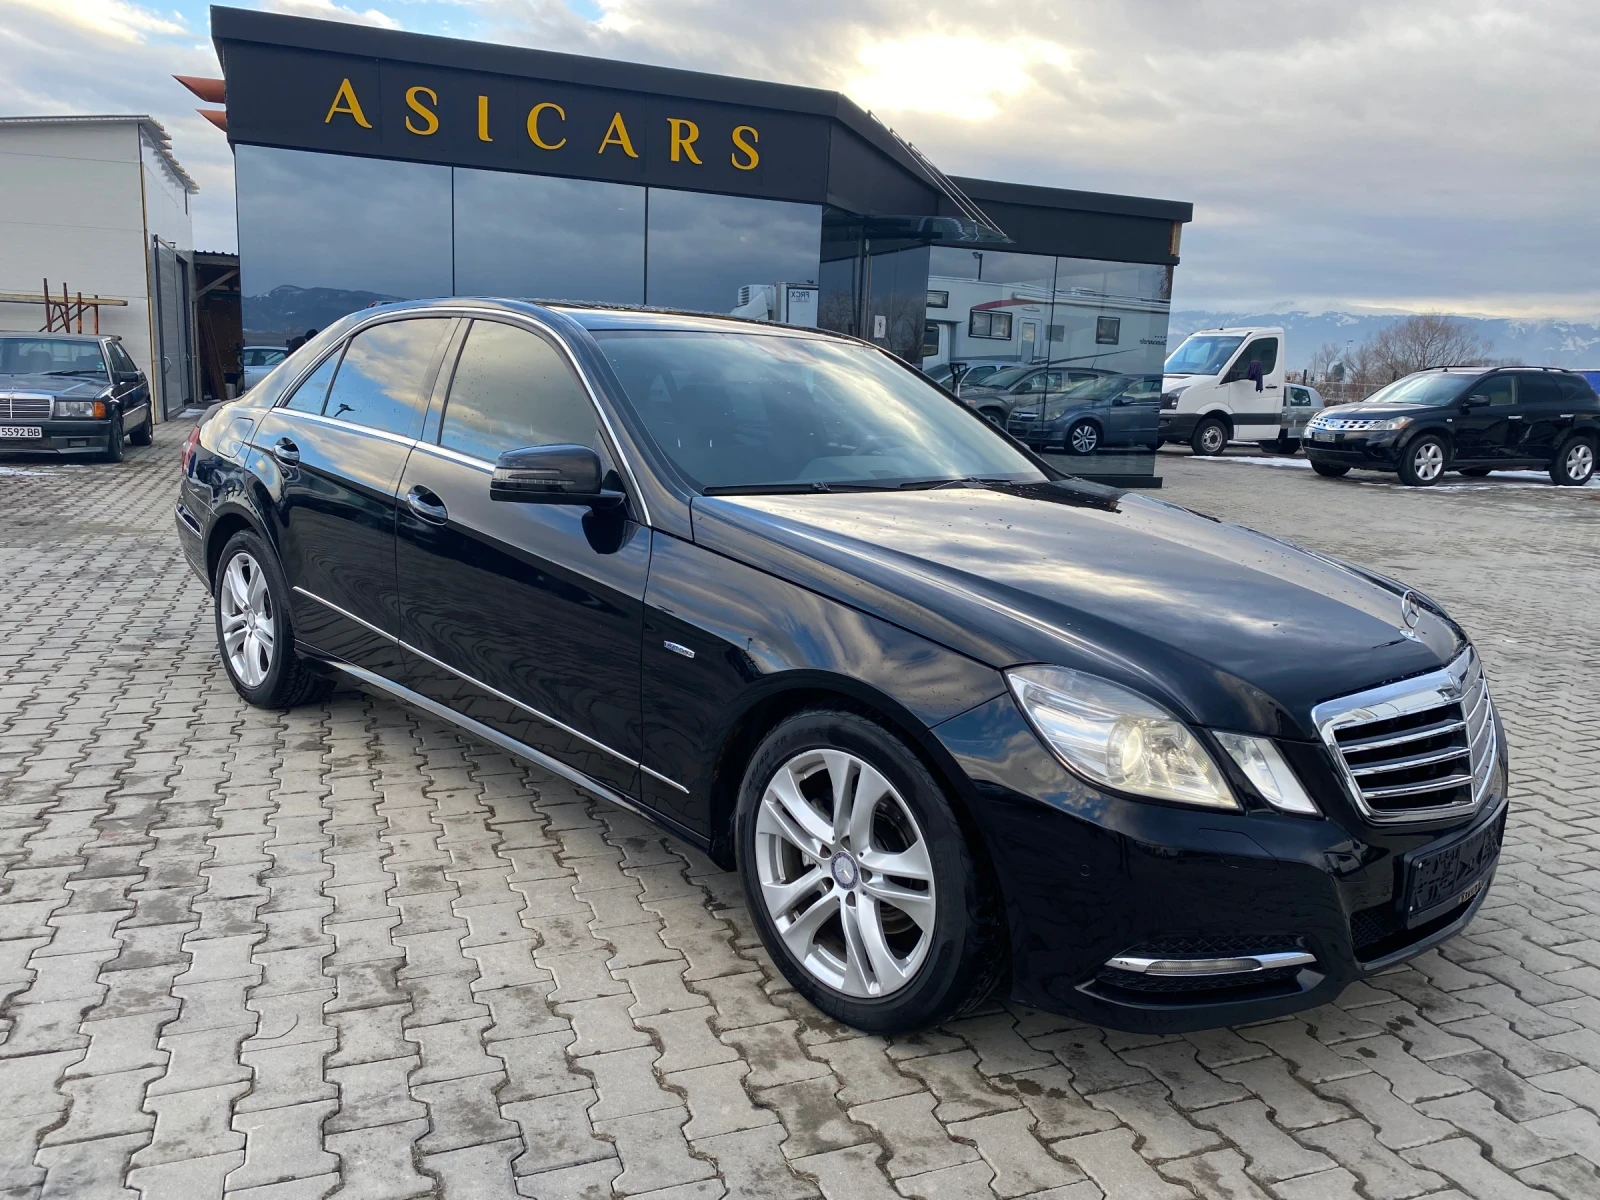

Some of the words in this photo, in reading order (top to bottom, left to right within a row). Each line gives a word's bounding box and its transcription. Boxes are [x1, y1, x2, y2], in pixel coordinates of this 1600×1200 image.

[324, 77, 760, 170] ASICARS
[1, 427, 26, 437] 5592
[27, 428, 41, 437] BB
